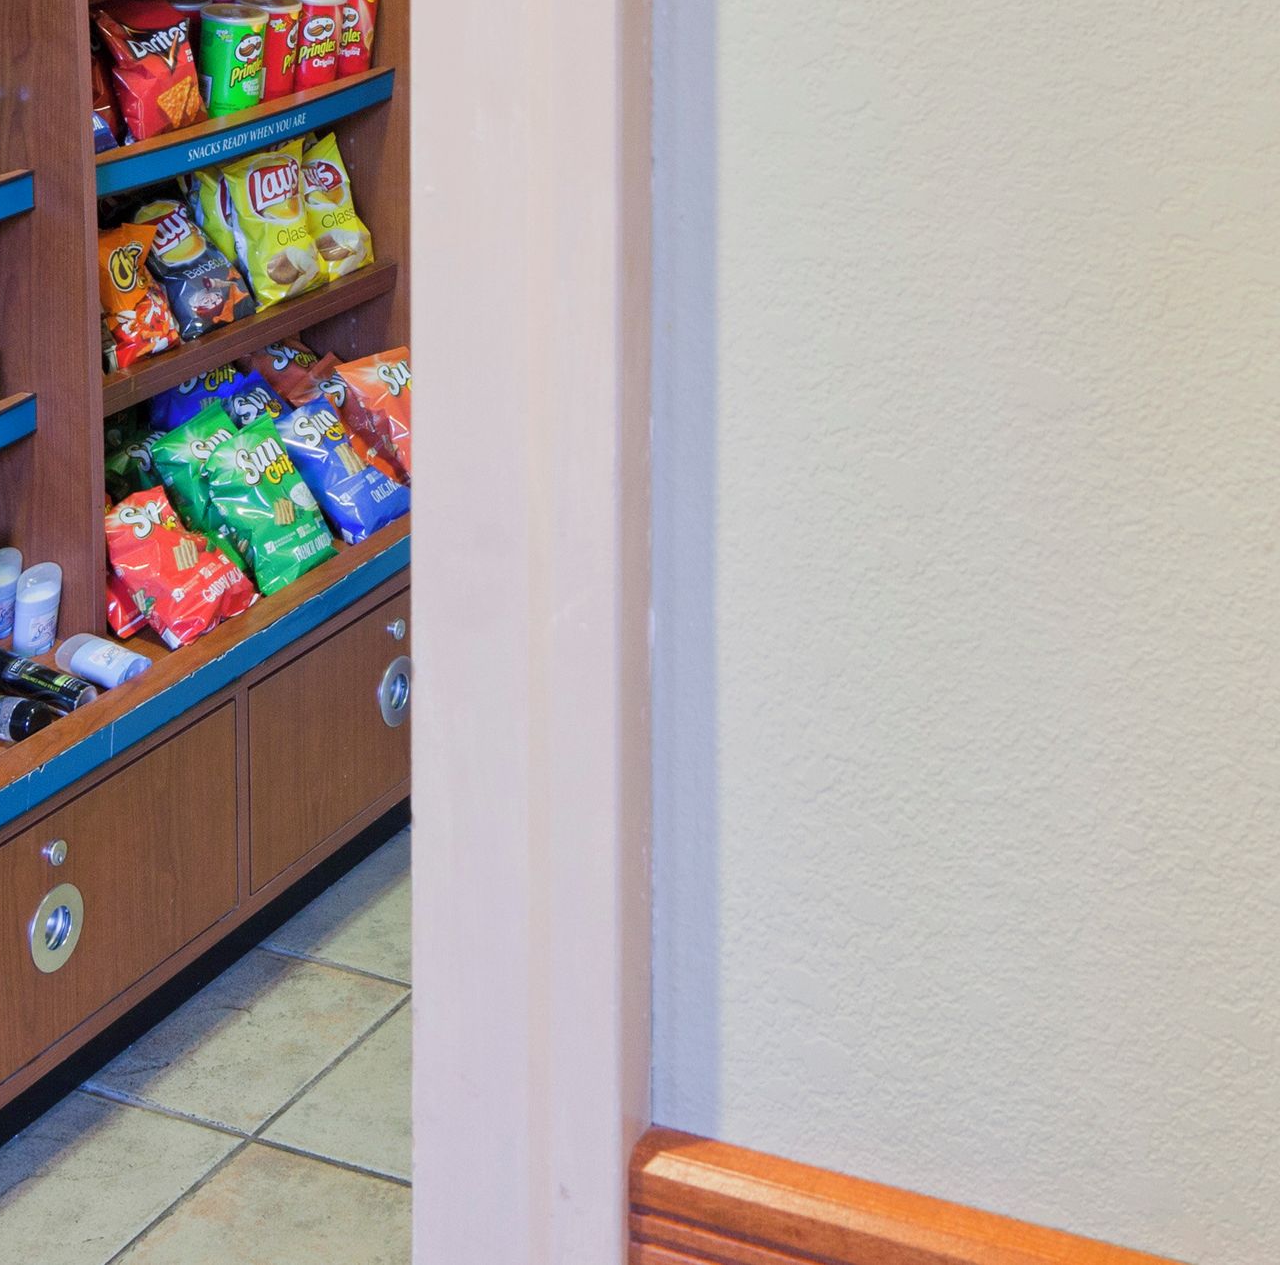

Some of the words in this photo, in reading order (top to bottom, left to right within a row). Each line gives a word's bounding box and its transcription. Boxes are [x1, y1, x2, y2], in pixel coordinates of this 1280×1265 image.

[127, 19, 188, 59] Doritos
[298, 38, 336, 64] Pringles
[341, 28, 361, 47] gles
[187, 143, 221, 162] SNACKS
[222, 132, 249, 153] READY
[249, 125, 275, 146] WHEN
[274, 117, 293, 136] YOU
[292, 112, 307, 126] ARE
[250, 159, 299, 212] Lay's
[377, 360, 412, 397] Su
[293, 408, 339, 448] Sun
[236, 437, 285, 486] Sun
[265, 455, 295, 485] Chip
